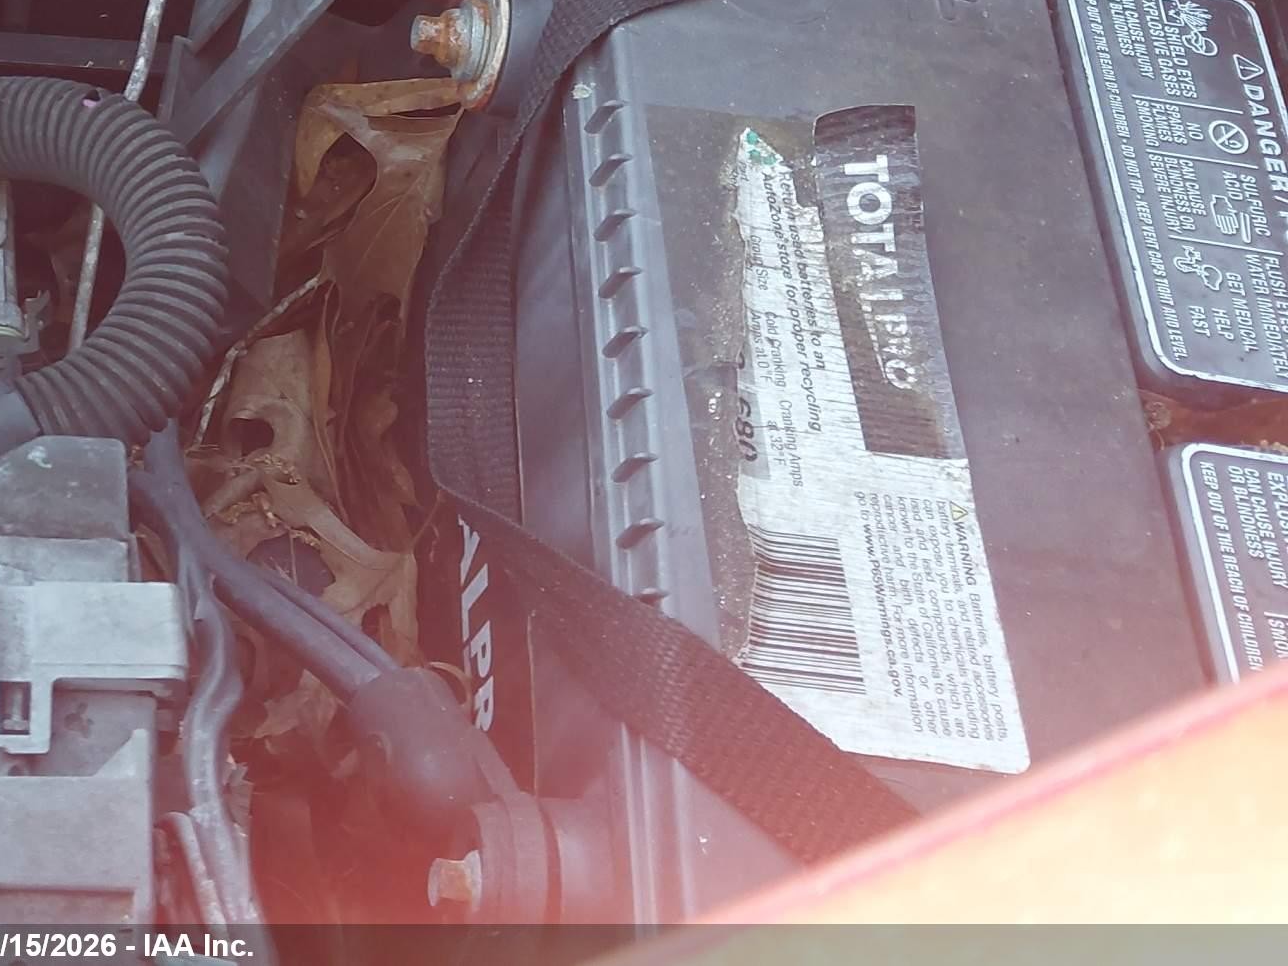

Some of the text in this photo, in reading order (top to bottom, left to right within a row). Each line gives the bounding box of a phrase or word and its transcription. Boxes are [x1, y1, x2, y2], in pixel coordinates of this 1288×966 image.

[1085, 5, 1101, 22] OUT
[1090, 22, 1105, 35] OF
[1108, 2, 1134, 56] BLINDNESS
[1124, 10, 1144, 42] CAUSE
[1093, 36, 1109, 51] THE
[1133, 43, 1154, 78] INJURY
[1164, 25, 1197, 98] SHIELD EYES
[1097, 52, 1116, 80] REACH
[1157, 58, 1180, 96] GASES
[1104, 81, 1119, 94] OF
[1107, 94, 1130, 137] CHILDREN
[1134, 99, 1158, 146] SMOKING
[1149, 101, 1172, 141] FLAMES
[1165, 104, 1187, 144] SPARKS
[1185, 121, 1203, 140] NO
[1120, 144, 1135, 157] DO
[1124, 158, 1140, 177] NOT
[777, 171, 797, 219] Return
[1129, 178, 1145, 194] TIP
[1148, 153, 1181, 233] SEVERE INJURY
[1163, 156, 1195, 230] BLINDNESS OR
[1178, 158, 1206, 215] CAN CAUSE
[1221, 170, 1243, 201] ACID
[1134, 200, 1153, 224] KEEP
[1239, 173, 1270, 236] SULFURIC
[788, 224, 805, 258] used
[1140, 225, 1159, 248] VENT
[776, 242, 793, 279] store
[1147, 250, 1166, 276] CAPS
[1263, 256, 1288, 301] FLUSH
[785, 283, 799, 303] for
[795, 262, 819, 327] batteries
[1154, 277, 1173, 305] TIGHT
[1162, 306, 1179, 327] AND
[1187, 304, 1210, 337] FAST
[1211, 307, 1233, 340] HELP
[1225, 271, 1259, 353] GET MEDICAL
[1244, 253, 1288, 379] WATER IMMEDIATELY
[787, 307, 808, 359] proper
[813, 350, 826, 368] an
[797, 361, 824, 432] recycling
[1198, 461, 1219, 489] KEEP
[853, 490, 867, 506] go
[859, 508, 871, 521] to
[909, 497, 923, 522] lead
[1205, 491, 1225, 514] OUT
[1226, 465, 1264, 558] OR BLINDNESS
[1265, 470, 1288, 553] EXPLOS
[915, 528, 929, 551] and
[1211, 515, 1228, 529] OF
[1243, 467, 1288, 588] CAN CAUSE INJURY
[1215, 532, 1234, 553] THE
[1221, 555, 1244, 593] REACH
[867, 491, 925, 733] reproductive harm. For more information
[882, 493, 939, 735] cancer and birth defects or other
[895, 495, 952, 737] known to the State of California to cause
[922, 498, 982, 740] can expose you to chemicals including
[933, 499, 995, 741] battery terminals, and related accessories
[1231, 595, 1249, 611] OF
[456, 514, 495, 734] ALPR
[925, 588, 954, 666] compounds,
[953, 520, 1009, 743] WARNING Batteries, battery posts,
[944, 672, 962, 711] which
[953, 717, 966, 738] are
